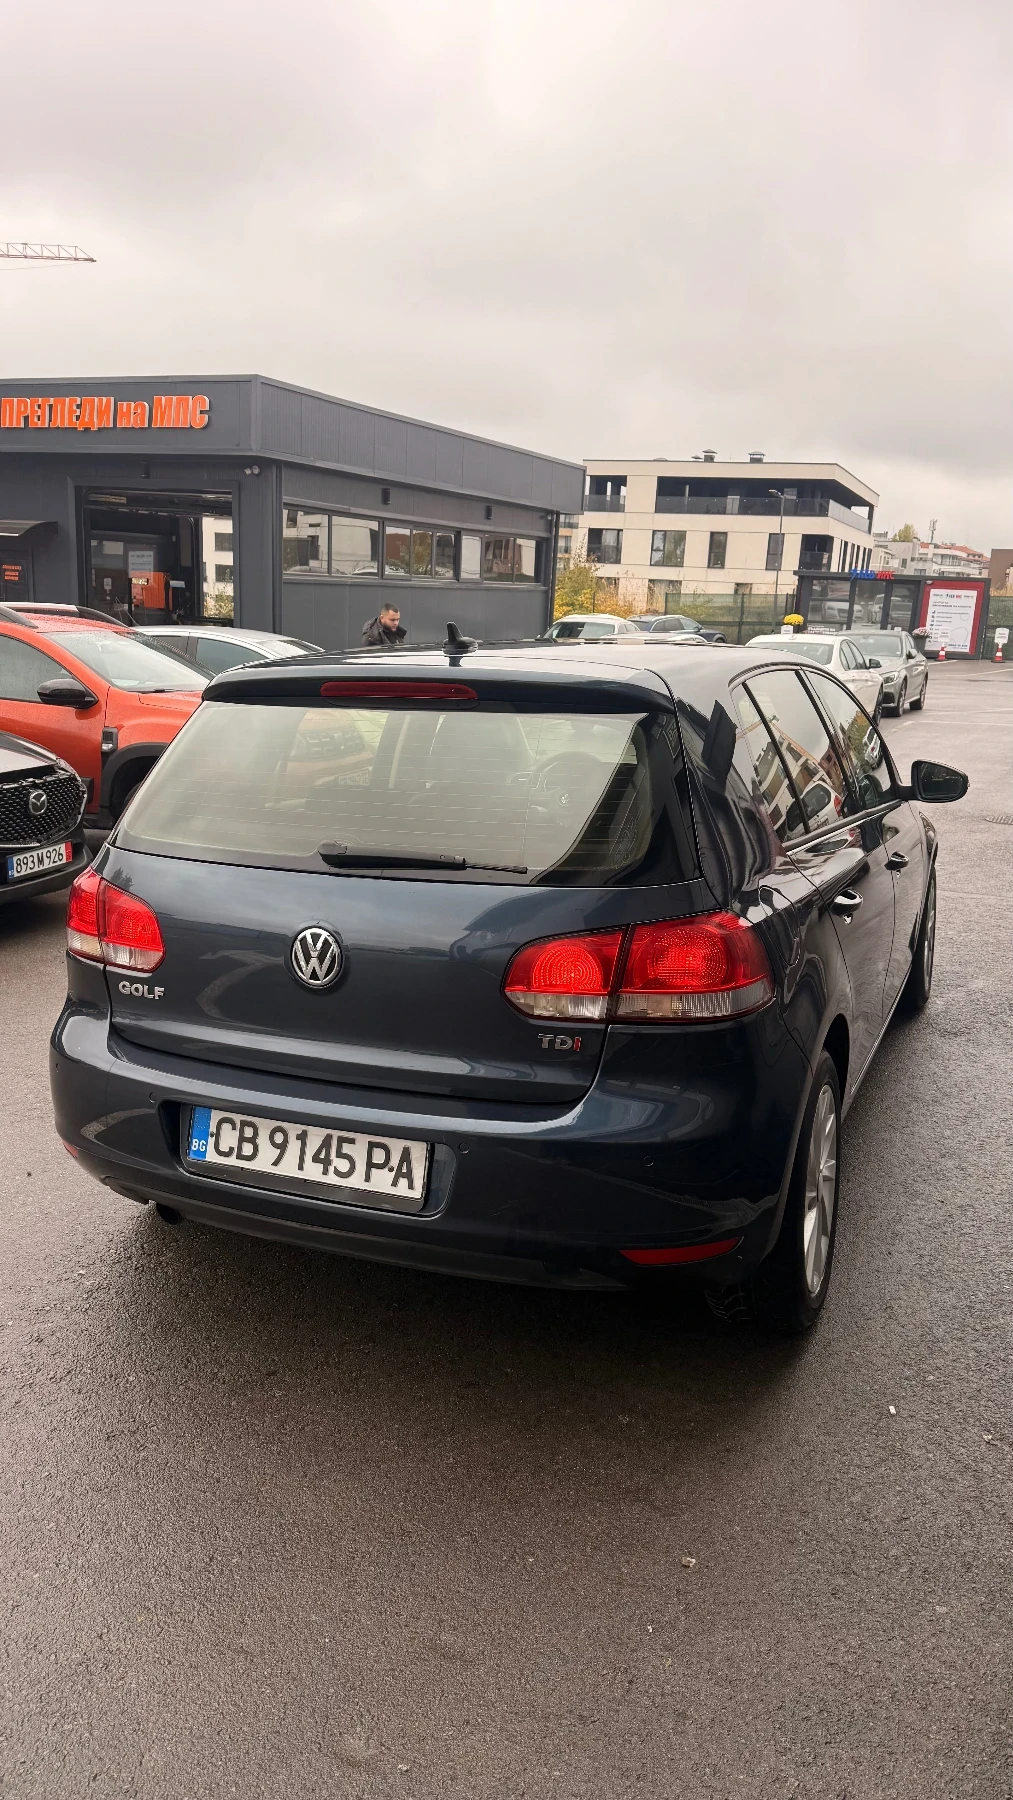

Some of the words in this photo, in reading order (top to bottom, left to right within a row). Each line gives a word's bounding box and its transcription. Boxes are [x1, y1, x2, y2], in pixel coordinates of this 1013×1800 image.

[1, 396, 115, 431] ПРЕГЛЕДИ
[117, 401, 149, 428] на
[152, 394, 210, 429] МПС
[15, 854, 36, 874] 893
[36, 851, 45, 869] M
[45, 846, 64, 866] 926
[118, 980, 165, 1000] GOLF
[537, 1033, 582, 1052] TDI
[191, 1138, 207, 1152] BG
[213, 1116, 260, 1162] CB
[268, 1125, 357, 1179] 9145
[364, 1140, 415, 1190] PA
